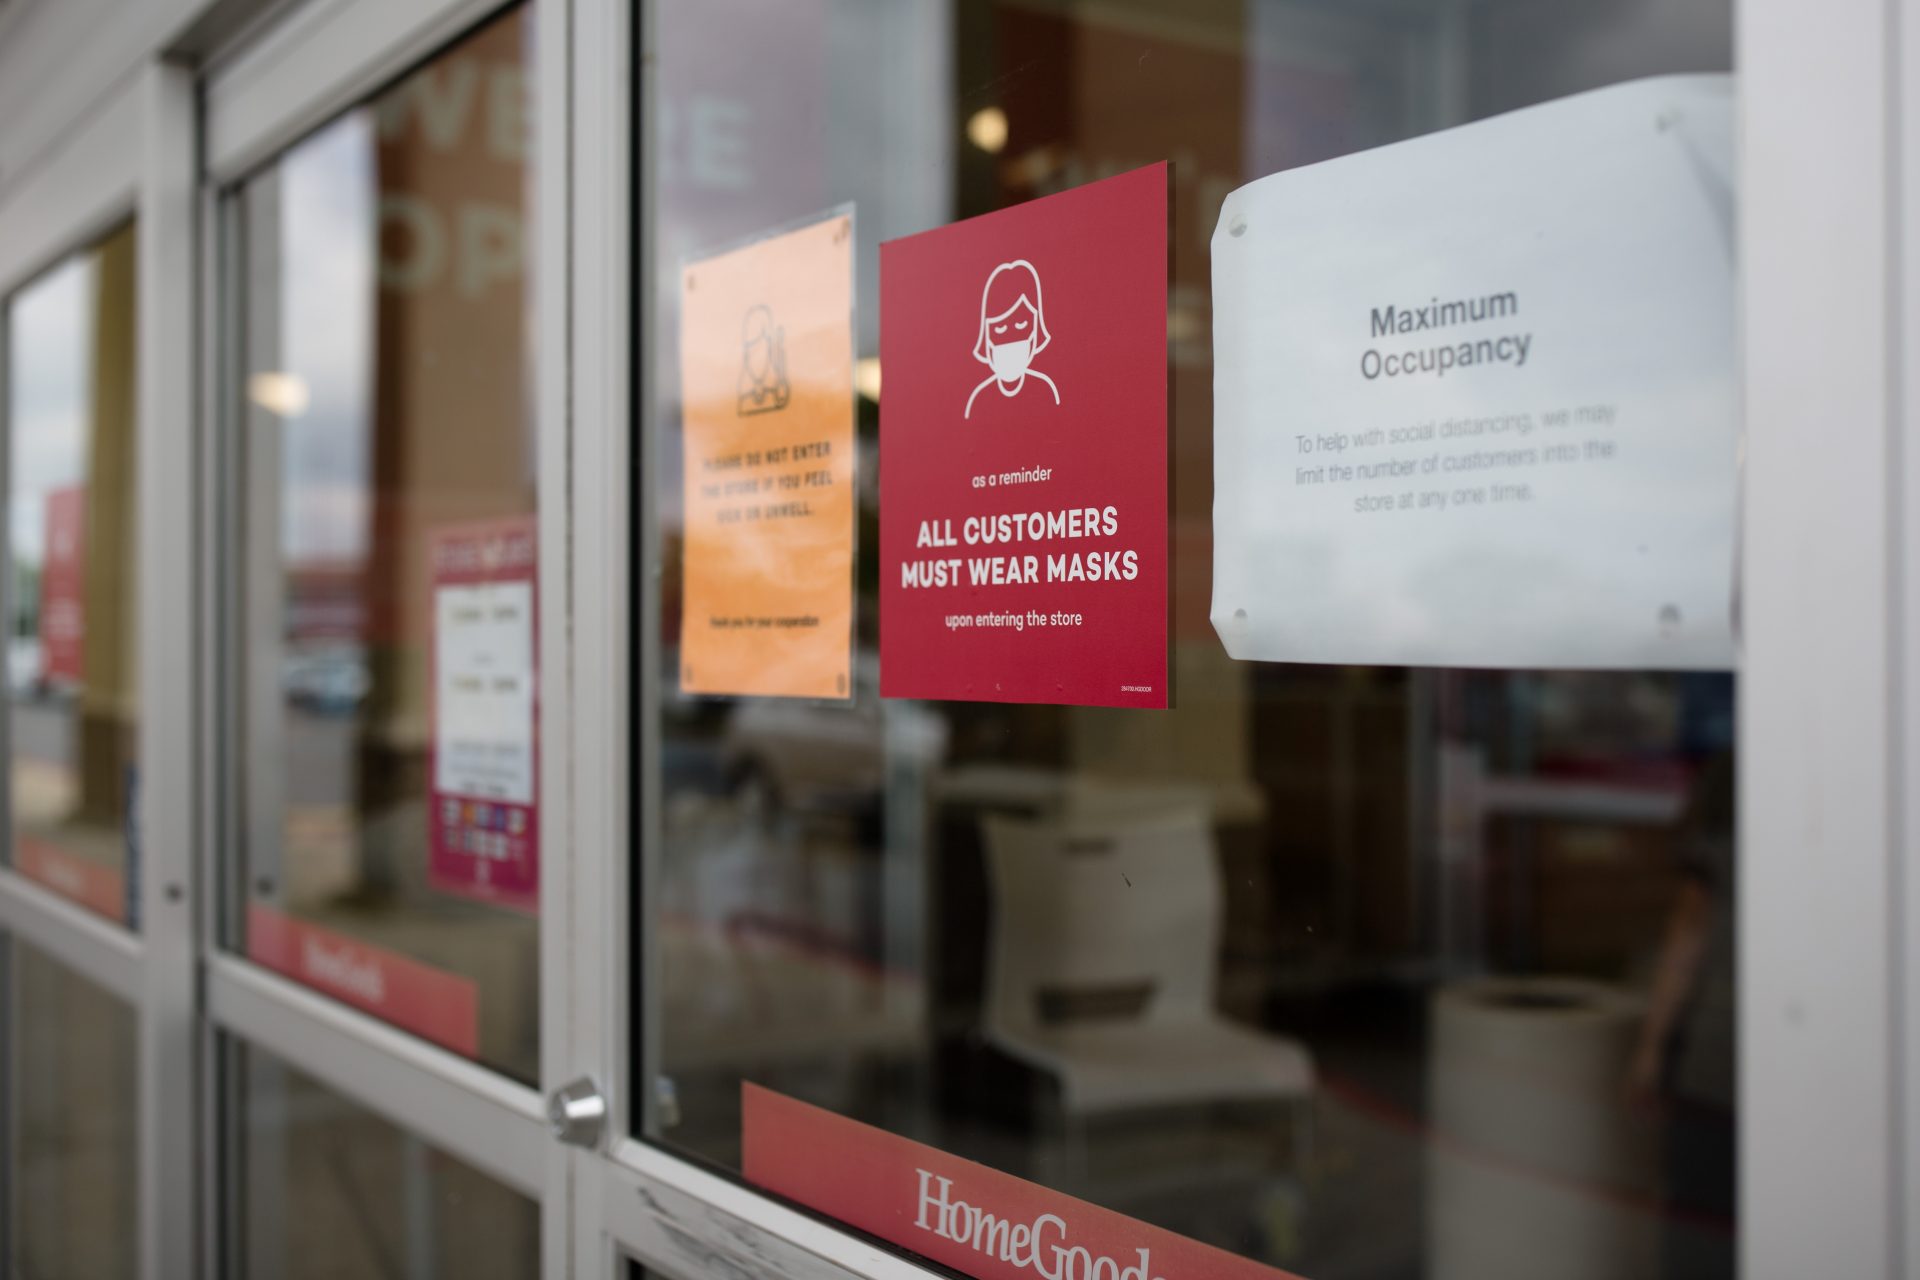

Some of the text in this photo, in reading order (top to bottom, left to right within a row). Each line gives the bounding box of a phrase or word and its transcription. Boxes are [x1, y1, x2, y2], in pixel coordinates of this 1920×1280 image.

[1370, 291, 1517, 338] Maximum
[1360, 333, 1532, 380] Occupancy
[1295, 434, 1312, 454] To
[1316, 432, 1348, 455] help
[1352, 428, 1384, 448] with
[1389, 420, 1435, 445] social
[1541, 408, 1569, 427] we
[1574, 403, 1617, 426] may
[765, 446, 788, 464] NOT
[792, 440, 831, 461] ENTER
[1295, 438, 1617, 485] limit the number of customers into the
[972, 465, 1052, 488] as a reminder
[1353, 491, 1394, 513] store
[1398, 489, 1414, 510] at
[1418, 490, 1447, 512] any
[1451, 486, 1485, 507] one
[916, 505, 1118, 548] ALL CUSTOMERS
[901, 549, 1139, 589] MUST WEAR MASKS
[945, 609, 1082, 631] upon entering the store
[914, 1168, 1167, 1280] HomeGood
